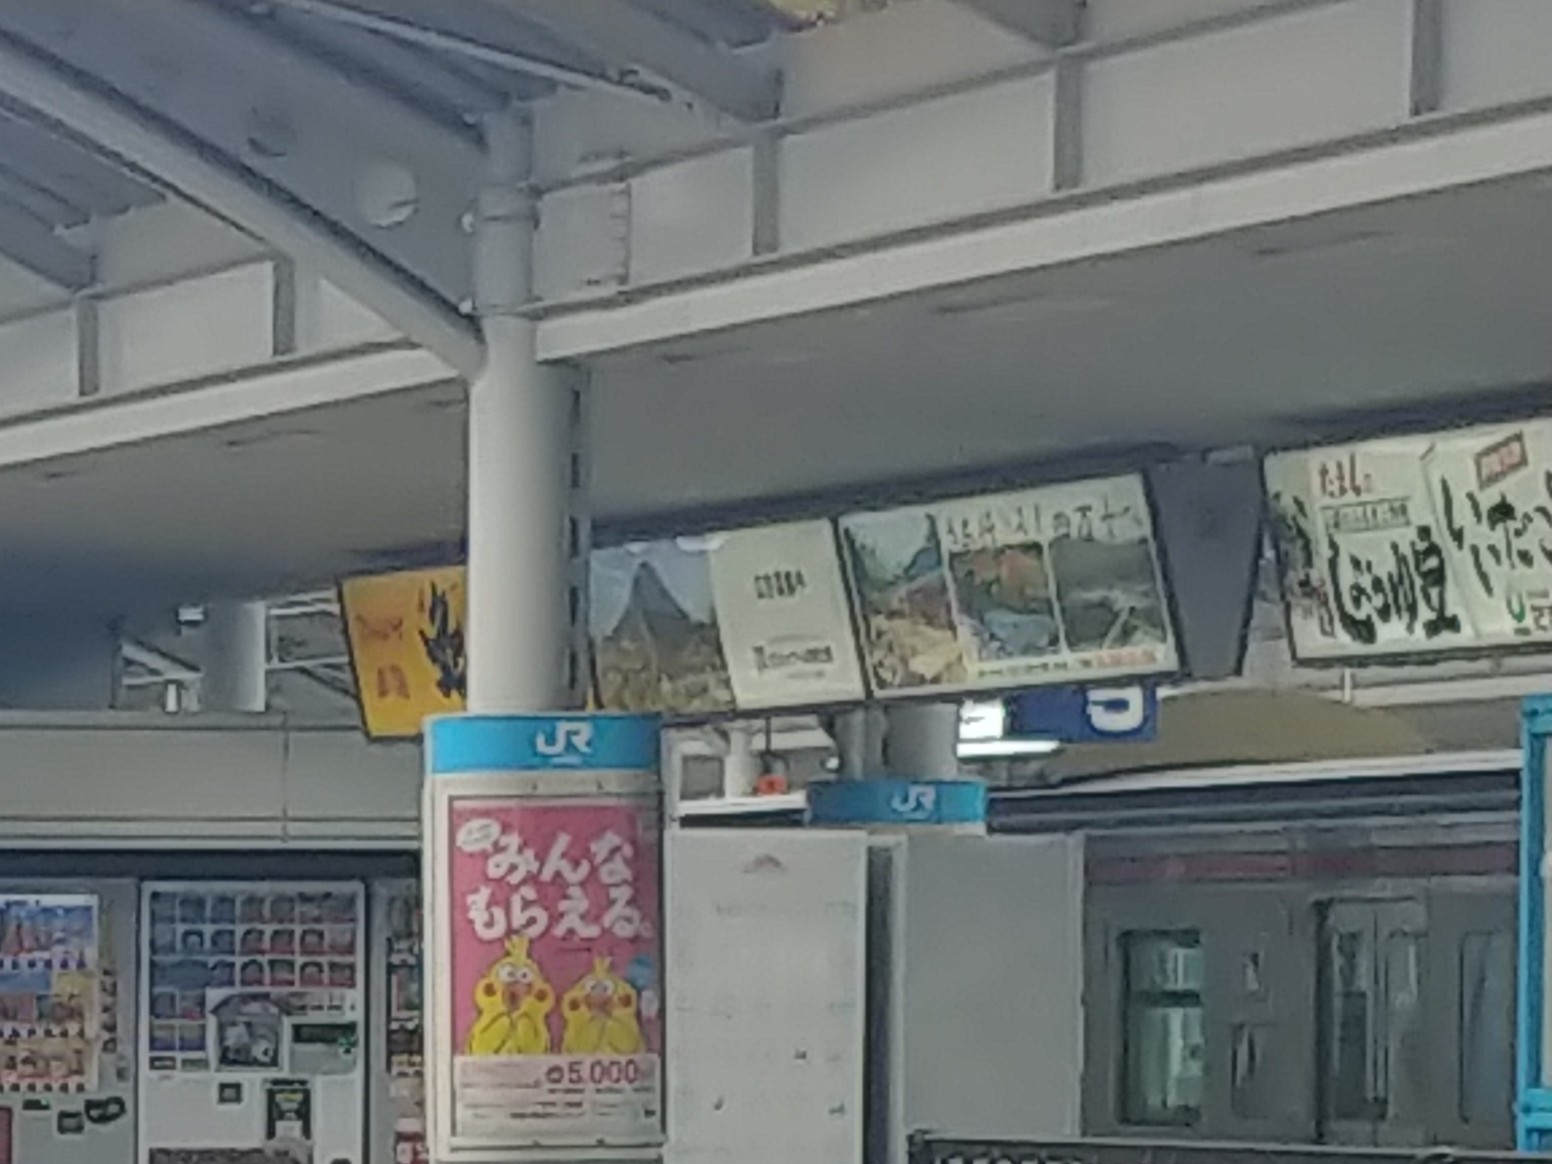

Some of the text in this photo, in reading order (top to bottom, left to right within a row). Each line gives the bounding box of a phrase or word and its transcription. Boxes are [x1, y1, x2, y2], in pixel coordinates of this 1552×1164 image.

[535, 721, 593, 754] JR
[891, 784, 937, 812] JR
[486, 830, 635, 885] みんな
